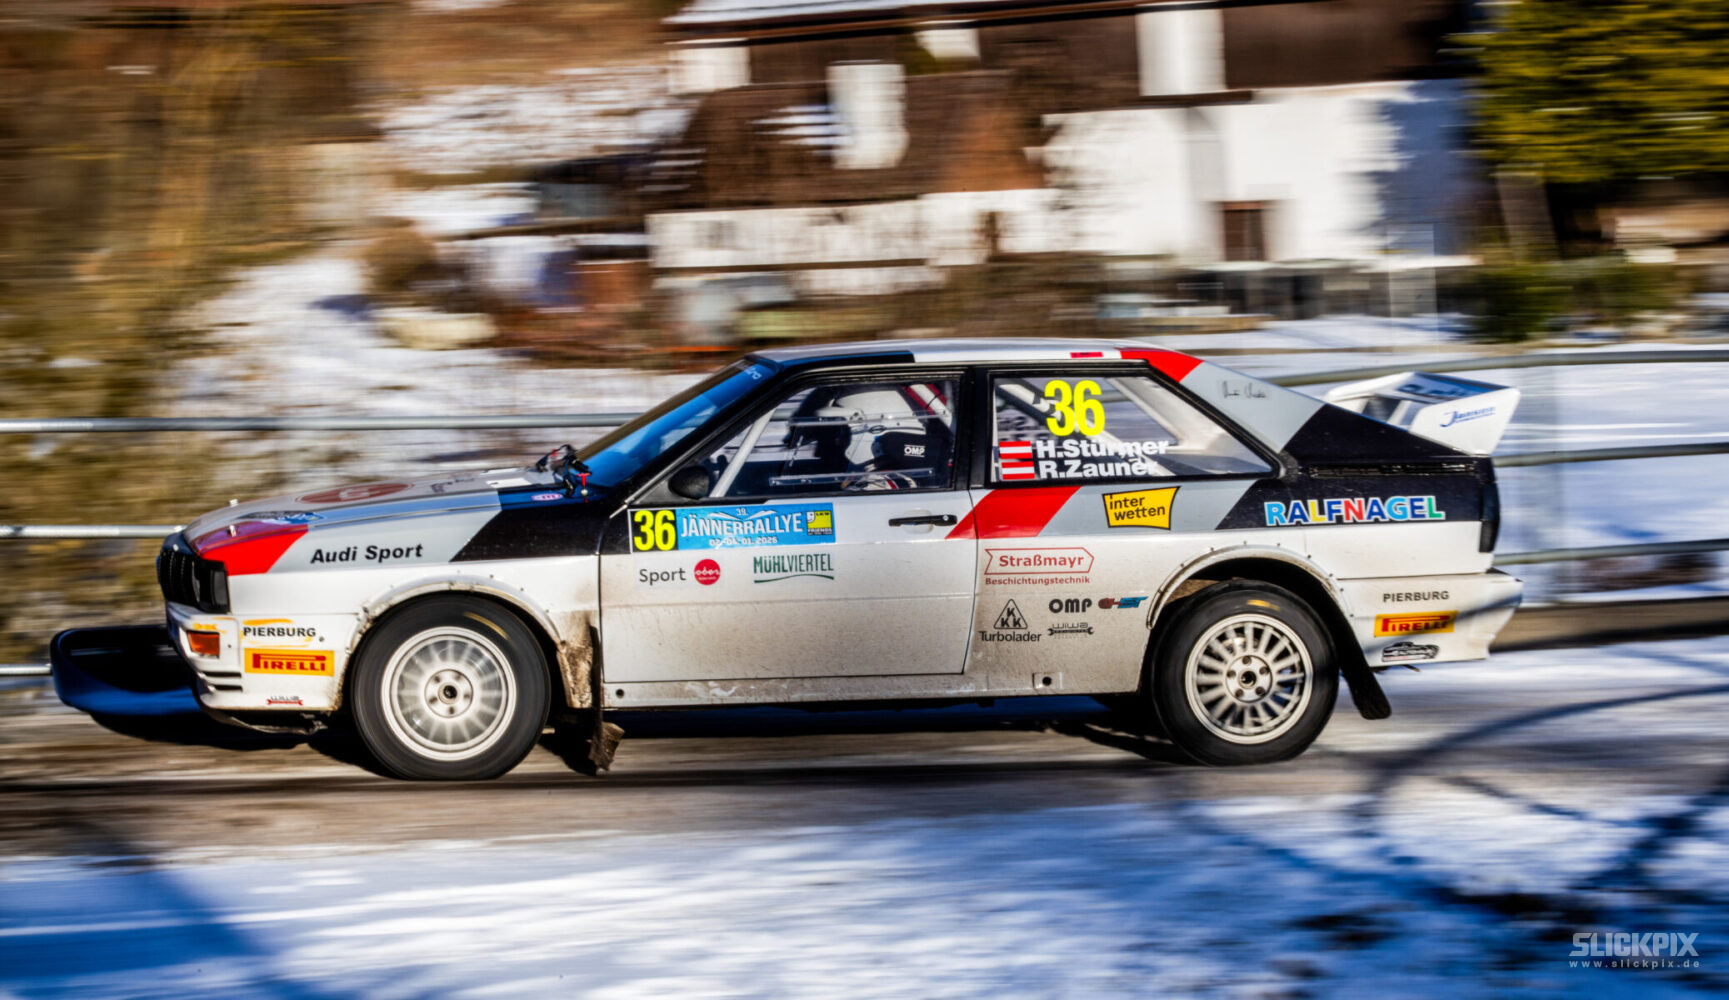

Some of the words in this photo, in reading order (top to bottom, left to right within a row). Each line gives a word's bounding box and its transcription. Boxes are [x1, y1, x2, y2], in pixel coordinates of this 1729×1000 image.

[1044, 379, 1106, 437] 36
[904, 446, 925, 455] OMP
[1038, 459, 1158, 479] R.Zauner
[1110, 495, 1145, 510] inter
[1264, 495, 1446, 526] RALFNAGEL
[1114, 505, 1166, 521] wetten
[633, 509, 677, 551] 36
[681, 512, 803, 537] JÄNNERRALLYE
[310, 546, 358, 564] Audi
[365, 544, 424, 563] Sport
[999, 554, 1085, 569] Straßmayr
[753, 553, 834, 574] MÜHLVIERTEL
[639, 567, 686, 586] Sport
[985, 575, 1090, 586] Beschichtungstechnik
[1049, 598, 1092, 613] OMP
[1383, 590, 1450, 603] PIERBURG
[1382, 614, 1451, 632] PIRELLI
[243, 627, 316, 638] PIERBURG
[978, 630, 1042, 642] Turbolader
[252, 653, 327, 672] PIRELLI
